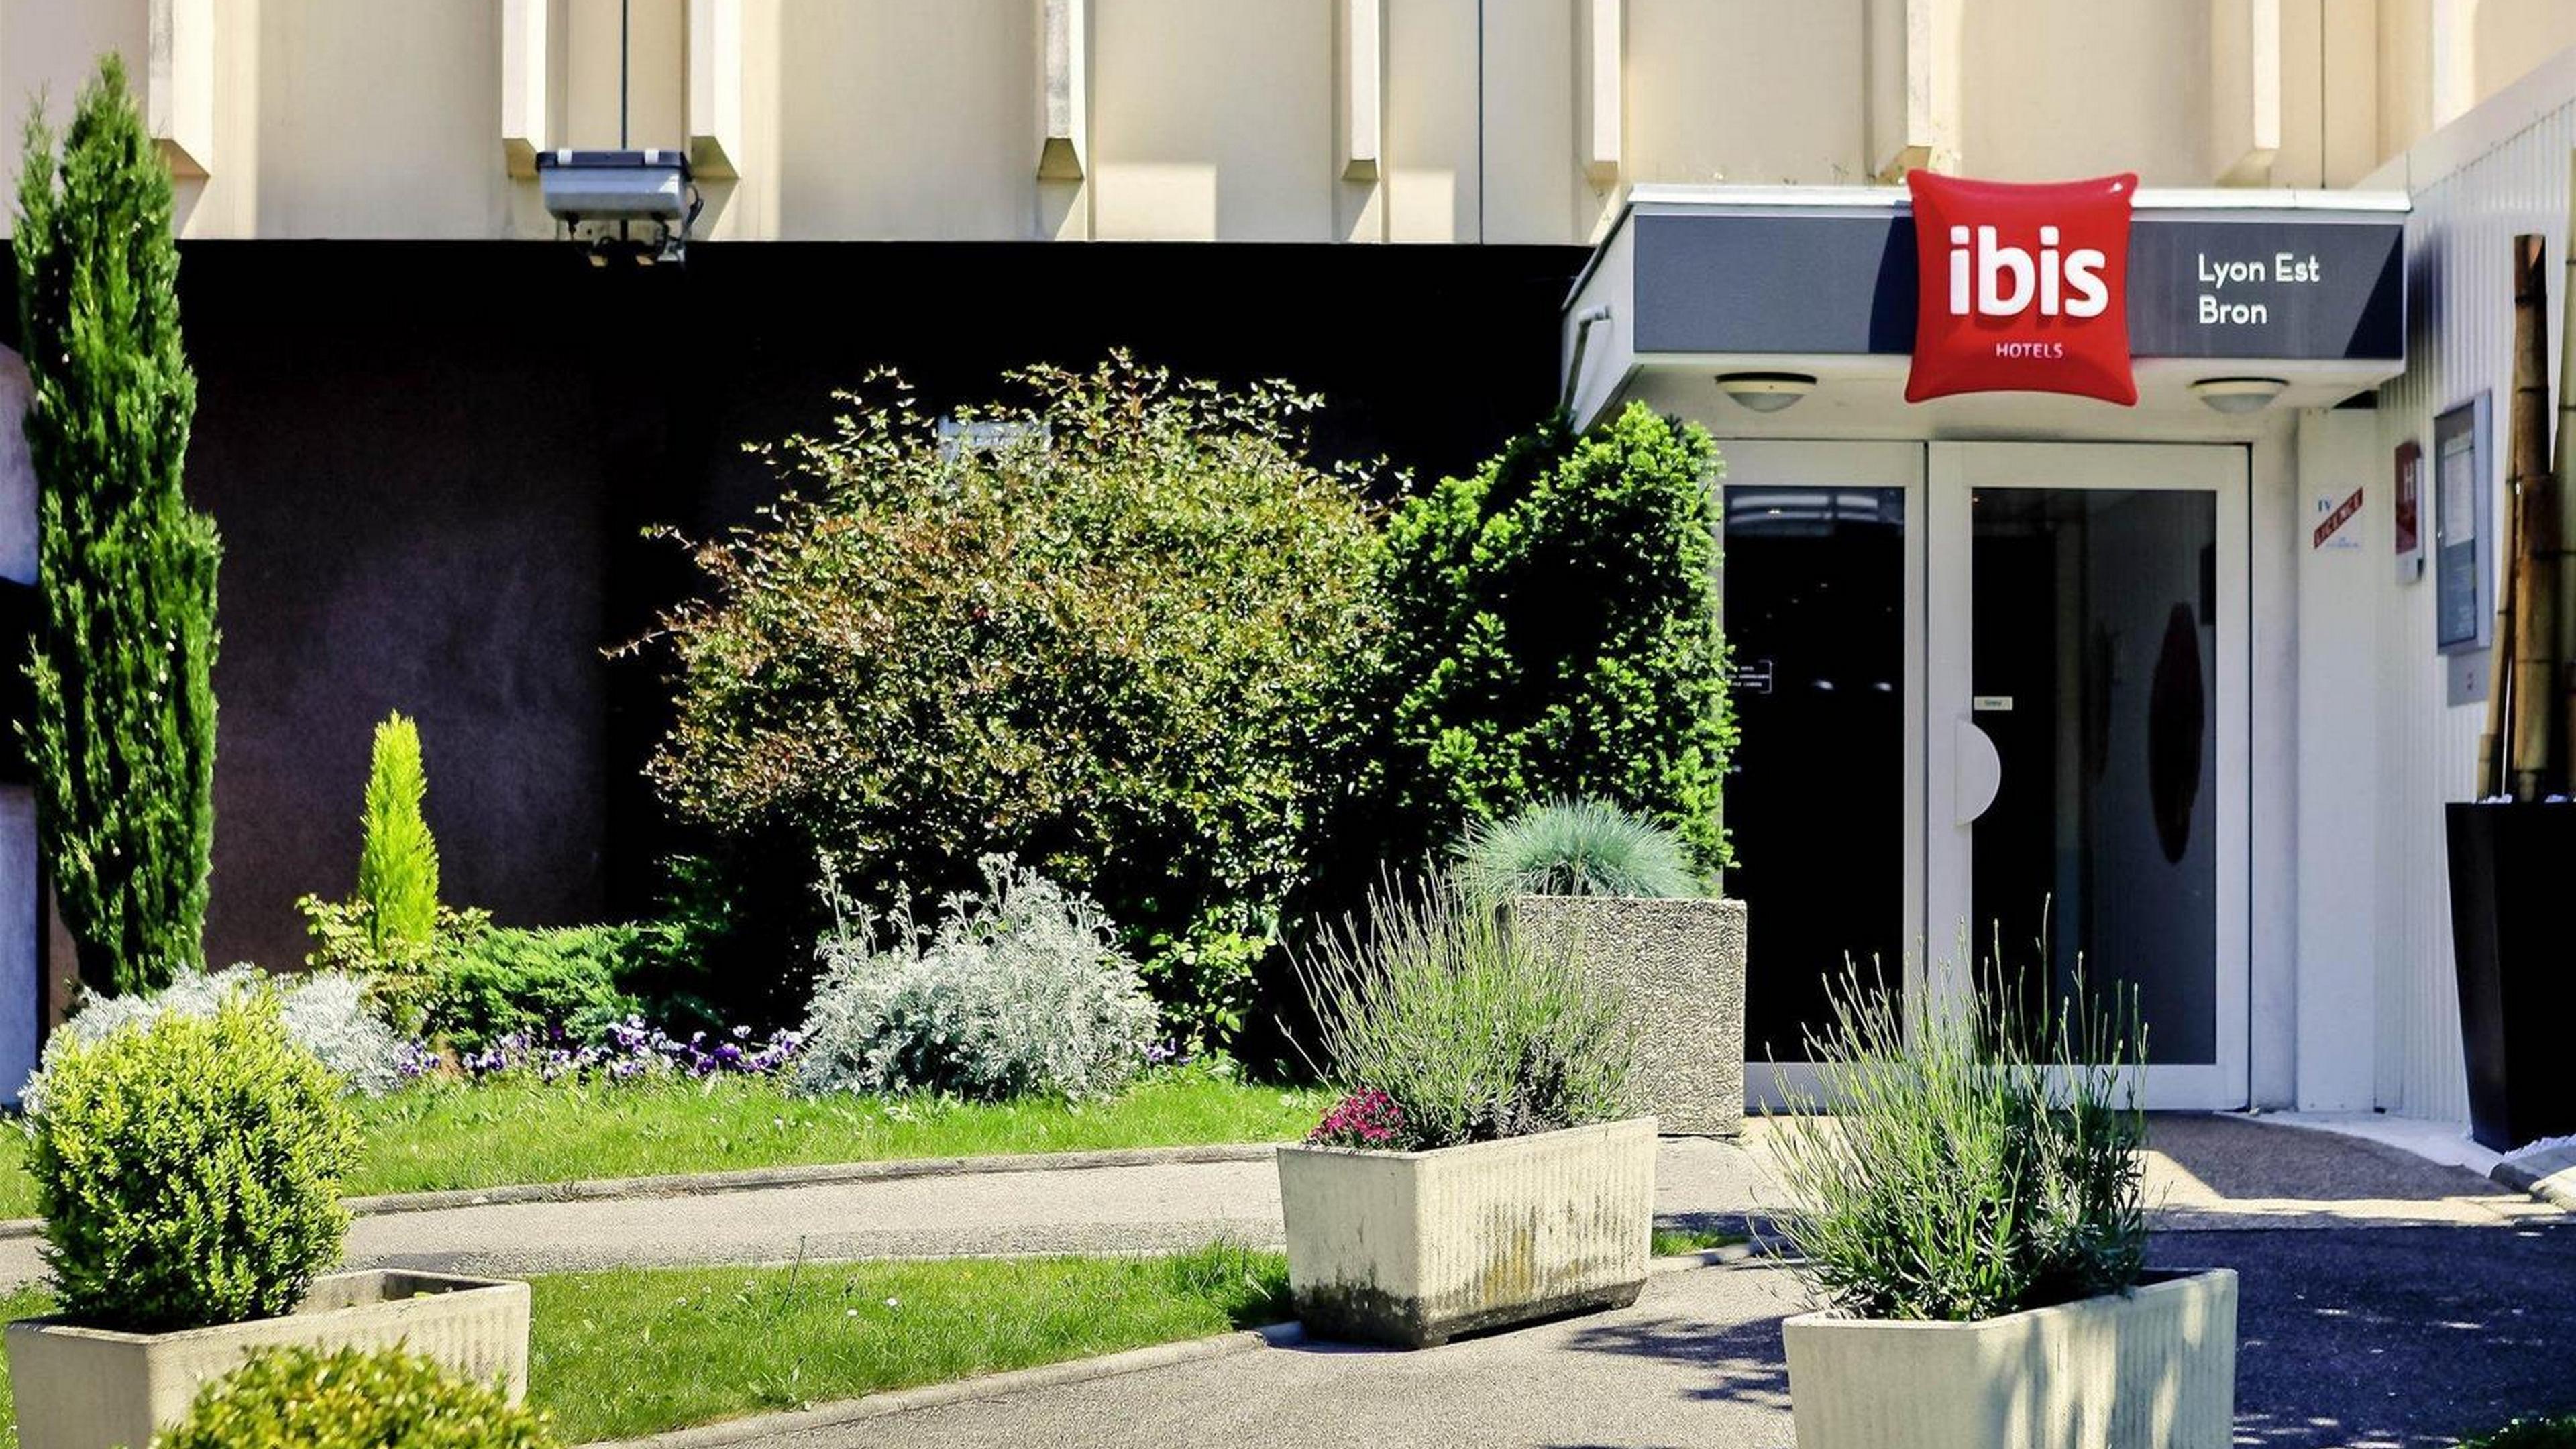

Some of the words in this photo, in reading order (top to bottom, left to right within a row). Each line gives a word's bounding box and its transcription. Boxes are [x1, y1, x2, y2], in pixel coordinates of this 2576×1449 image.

[1950, 225, 2108, 317] ibis
[2198, 252, 2265, 289] Lyon
[2275, 252, 2320, 282] Est
[2198, 294, 2267, 324] Bron
[1996, 343, 2063, 358] HOTELS
